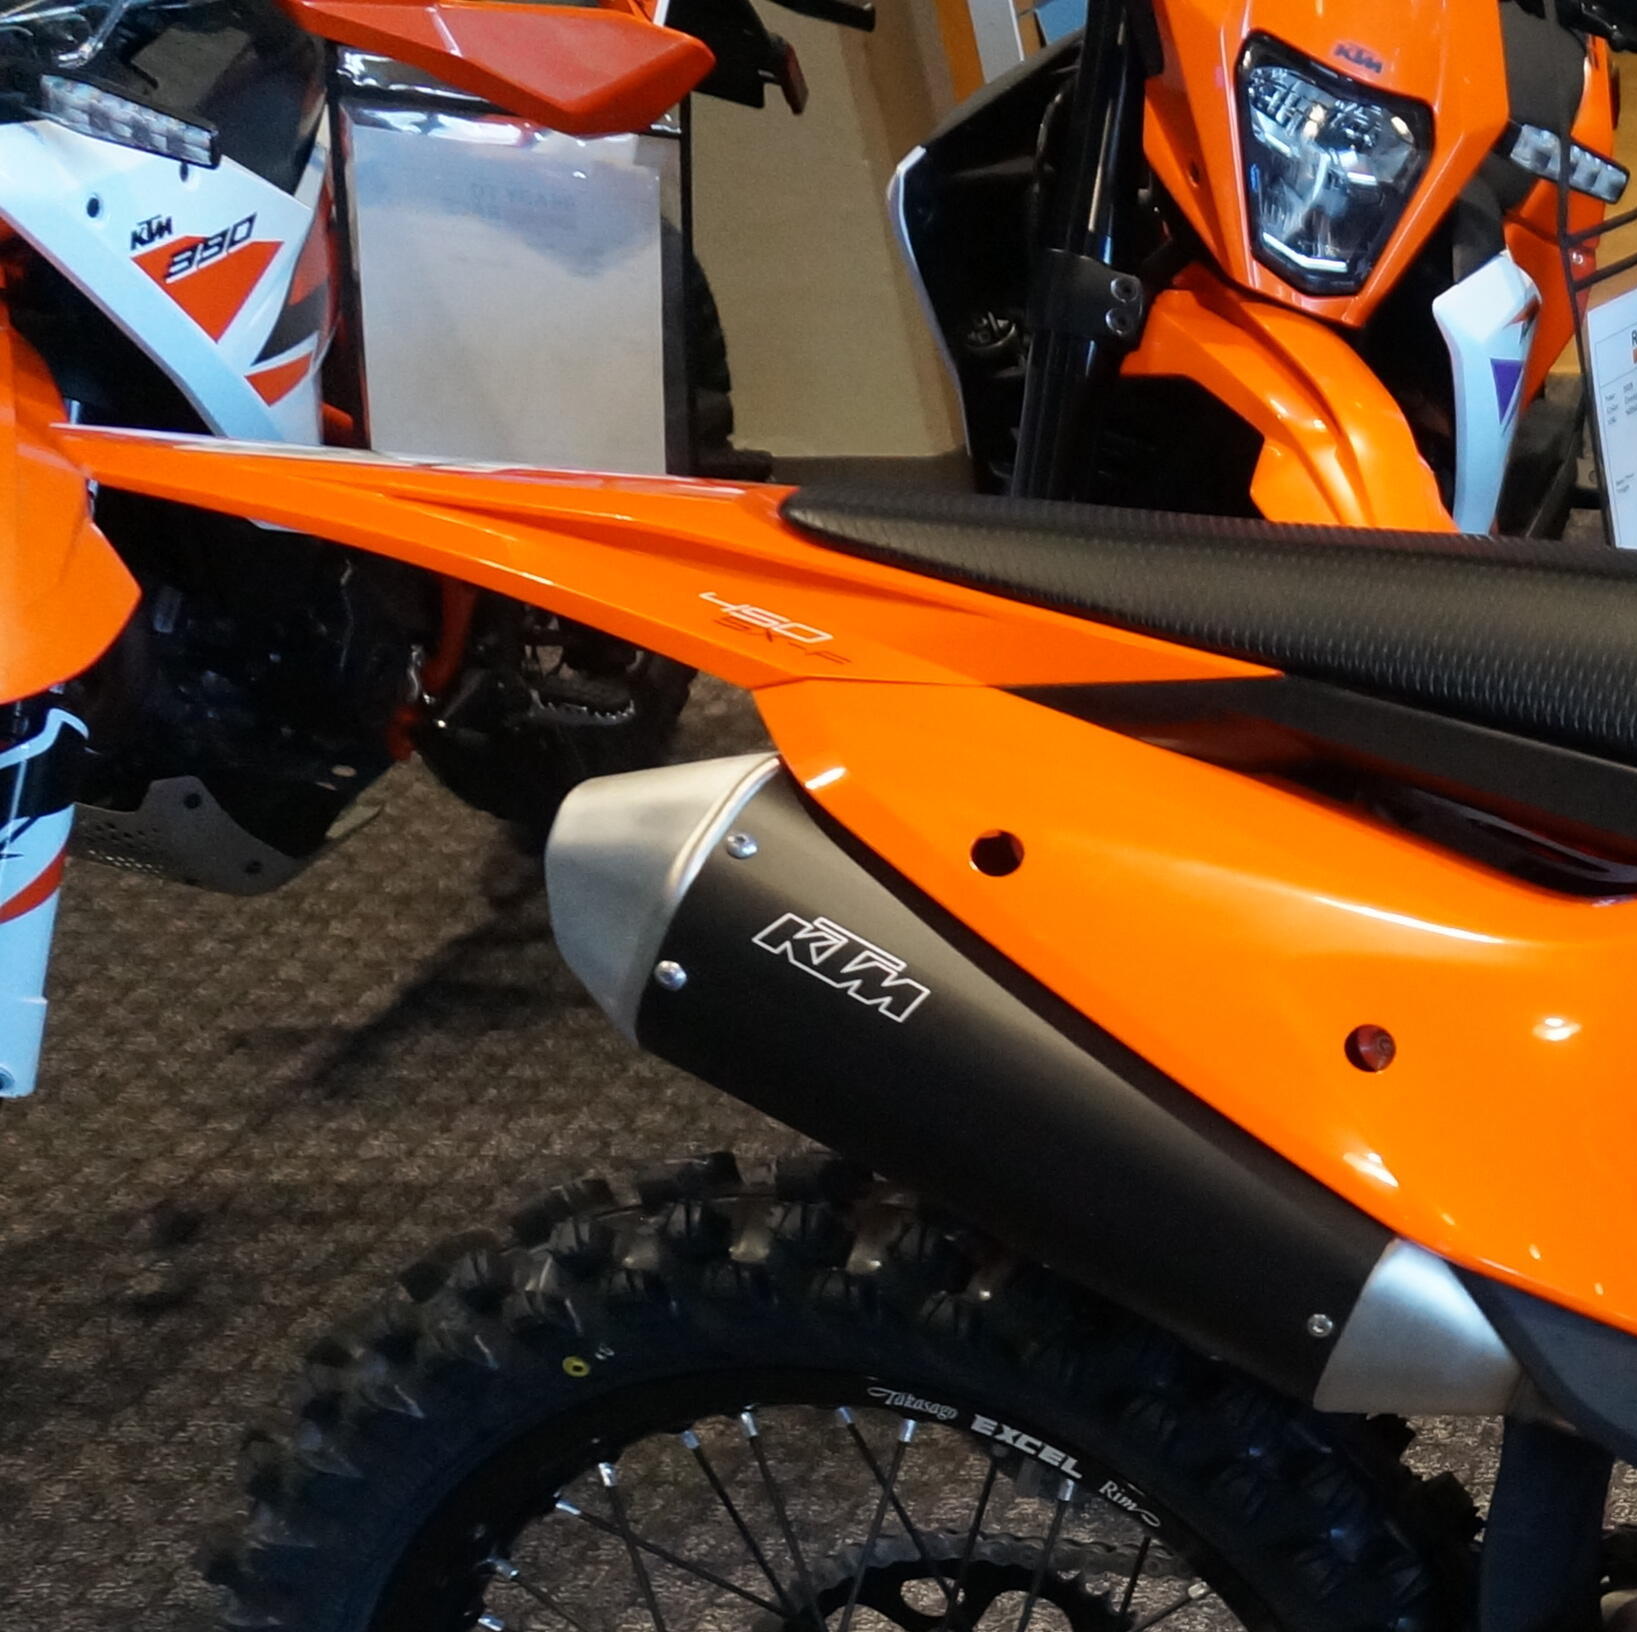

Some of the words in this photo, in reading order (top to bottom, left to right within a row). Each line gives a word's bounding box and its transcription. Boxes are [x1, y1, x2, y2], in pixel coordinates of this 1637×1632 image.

[130, 214, 173, 250] KTM
[163, 212, 257, 279] 390
[698, 591, 834, 643] 450
[752, 912, 931, 1023] KTM
[867, 1386, 959, 1421] Takasago
[970, 1413, 1083, 1480] EXCEL
[1099, 1479, 1160, 1528] Rim
